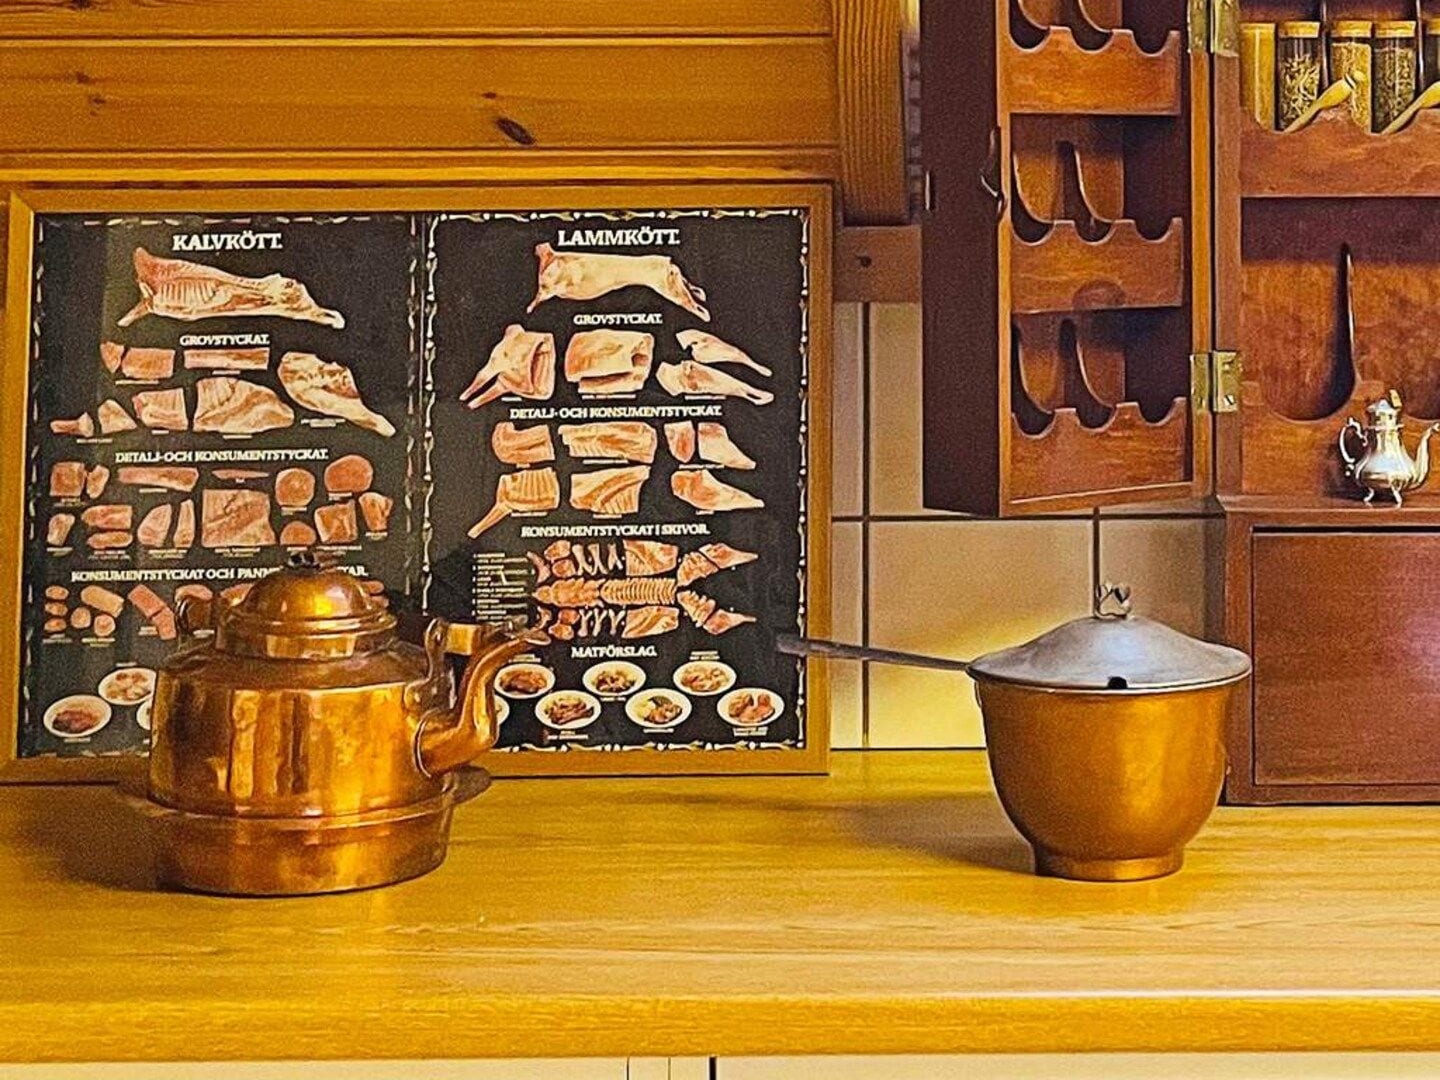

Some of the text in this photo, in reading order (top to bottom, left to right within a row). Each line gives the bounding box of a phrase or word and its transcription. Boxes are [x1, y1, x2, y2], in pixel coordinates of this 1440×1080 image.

[172, 230, 283, 251] KALVKÖTT.
[557, 226, 680, 247] LAMMKÖTT.
[205, 568, 233, 580] OCH
